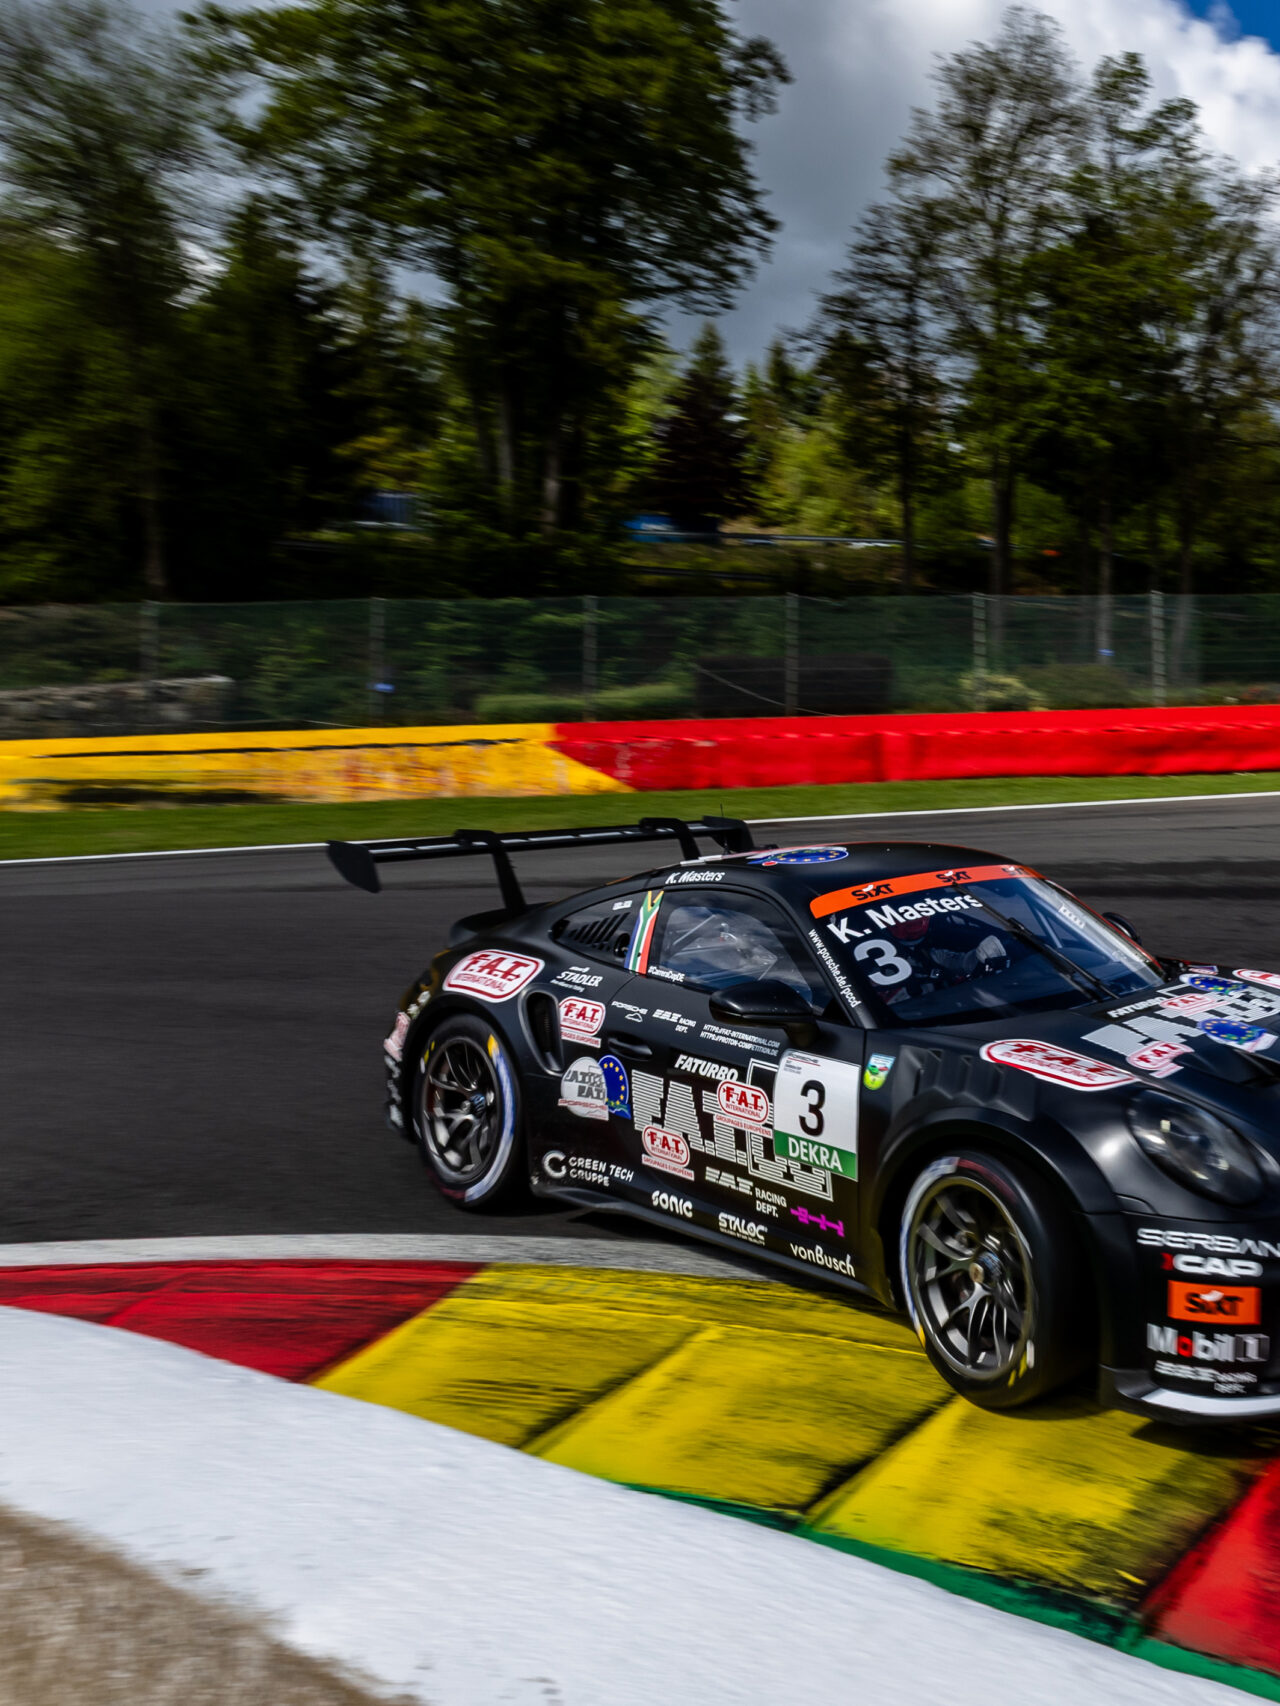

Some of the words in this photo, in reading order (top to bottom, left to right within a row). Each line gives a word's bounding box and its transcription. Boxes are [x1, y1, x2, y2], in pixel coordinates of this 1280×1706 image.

[665, 873, 677, 884] K.
[678, 871, 725, 883] Masters
[851, 884, 894, 901] SIXT
[827, 917, 872, 944] K.
[865, 894, 983, 929] Masters
[808, 928, 861, 1008] www.porsche.de/pccd
[853, 939, 912, 986] 3
[556, 971, 603, 987] STADLER
[564, 1002, 600, 1023] F.A.T.
[611, 1001, 648, 1015] PORSCHE
[674, 1054, 739, 1081] FATURBO
[723, 1085, 764, 1111] F.A.T.
[798, 1079, 826, 1137] 3
[725, 1103, 761, 1119] INTERNATIONAL
[647, 1131, 684, 1154] F.A.T.
[788, 1137, 843, 1172] DEKRA
[570, 1168, 610, 1187] GRUPPE
[609, 1164, 634, 1182] TECH
[755, 1187, 787, 1208] RACING
[756, 1201, 778, 1218] DEPT.
[718, 1212, 766, 1240] STALOC
[790, 1243, 856, 1278] vonBusch
[1146, 1323, 1236, 1362] Mobil
